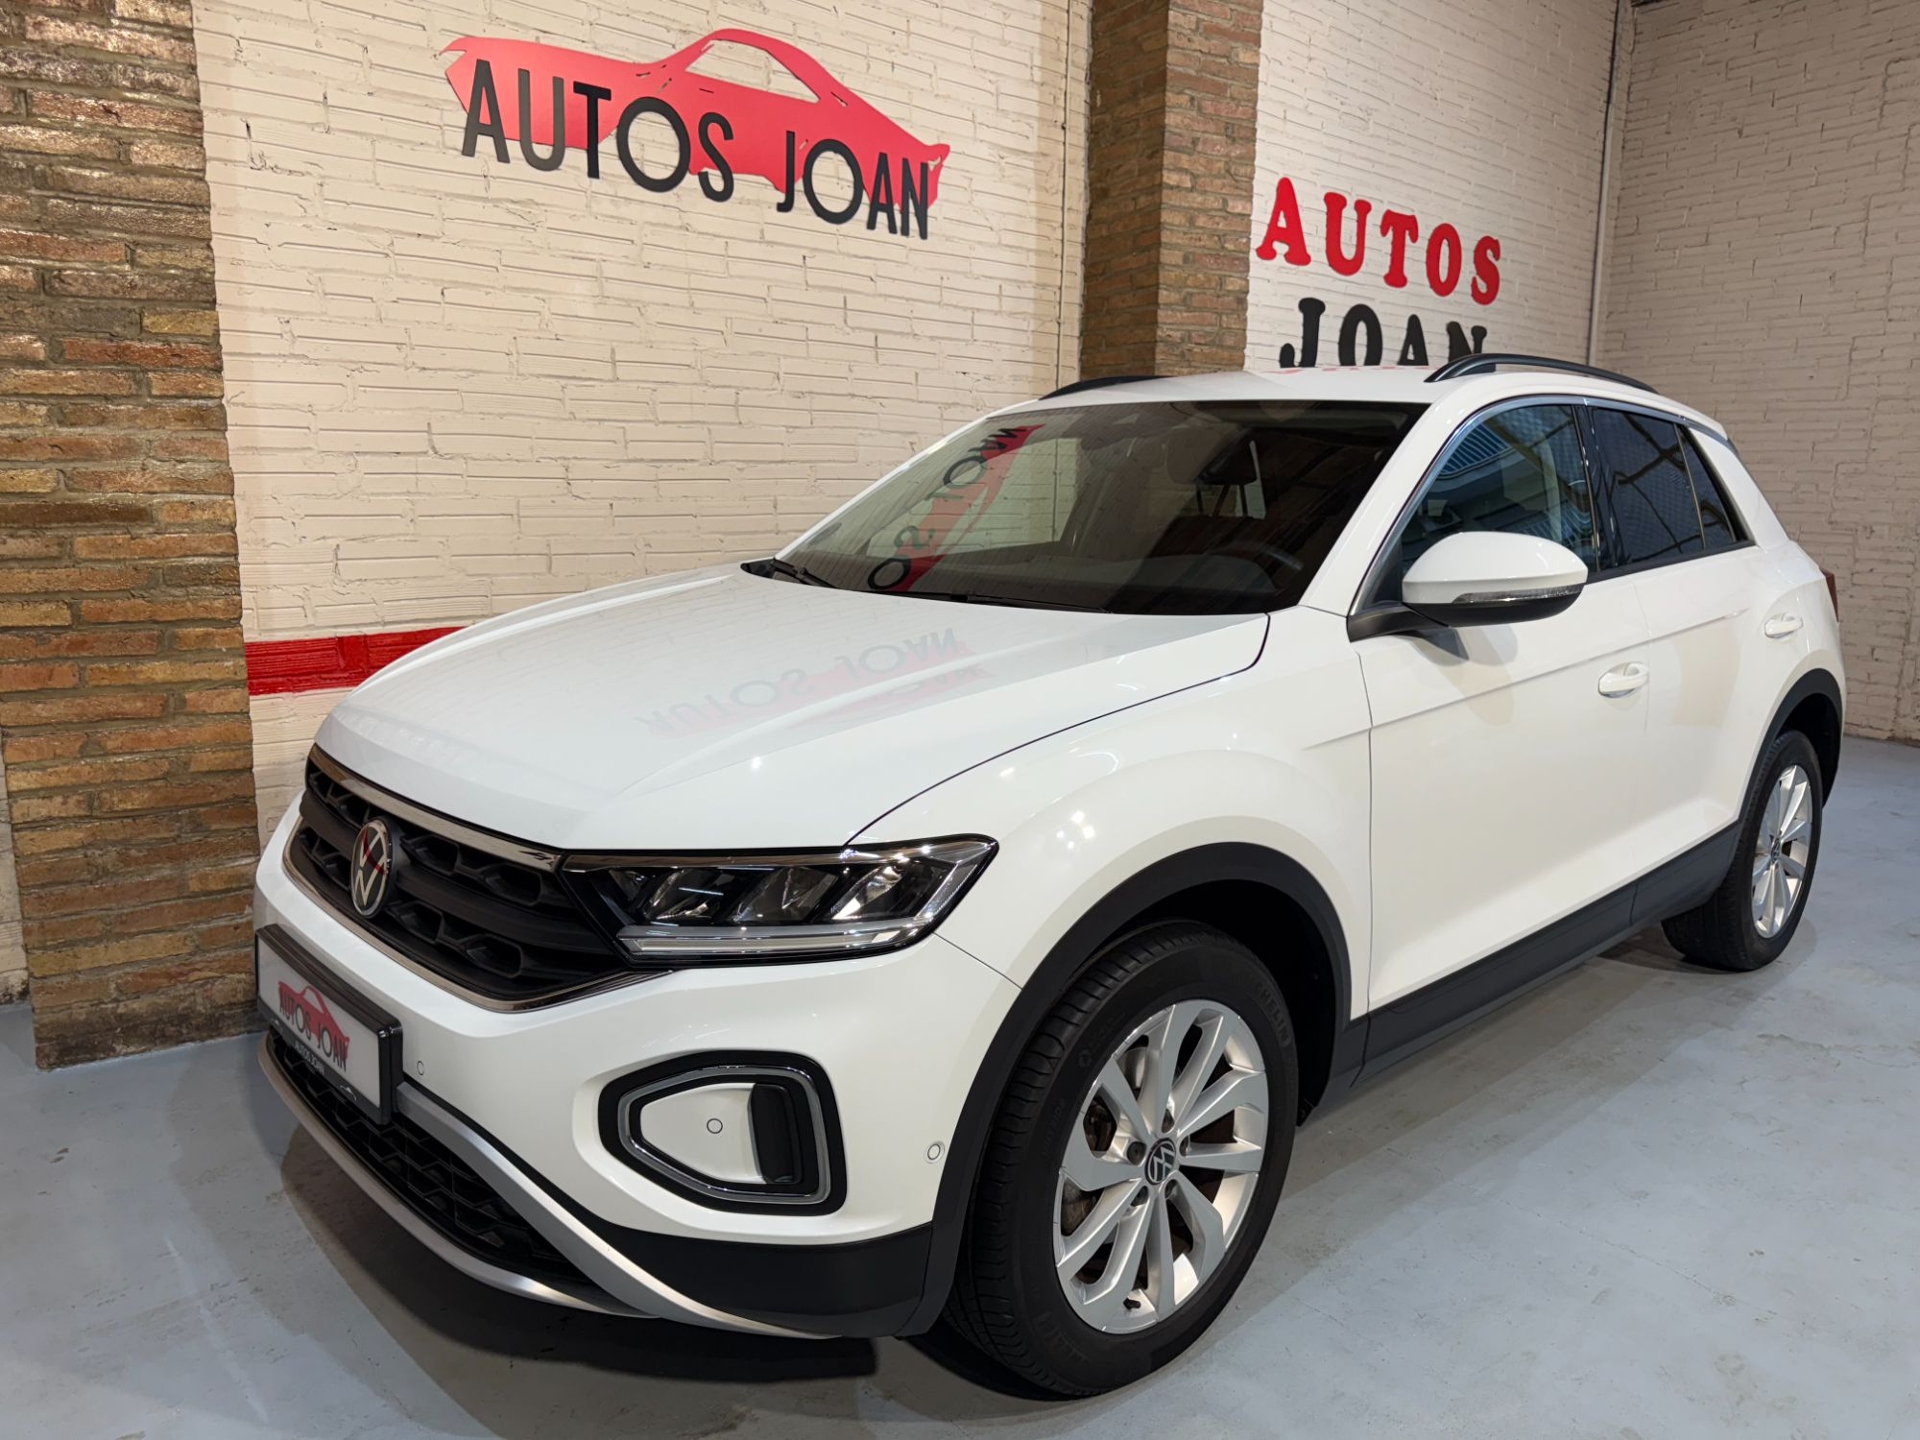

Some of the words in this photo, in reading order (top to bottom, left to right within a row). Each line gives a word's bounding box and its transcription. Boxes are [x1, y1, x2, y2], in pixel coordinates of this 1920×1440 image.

[462, 59, 734, 203] AUTOS
[777, 130, 928, 240] JOAN
[1255, 177, 1500, 305] AUTOS
[279, 985, 312, 1041] AUTOS
[317, 1020, 347, 1073] JOAN
